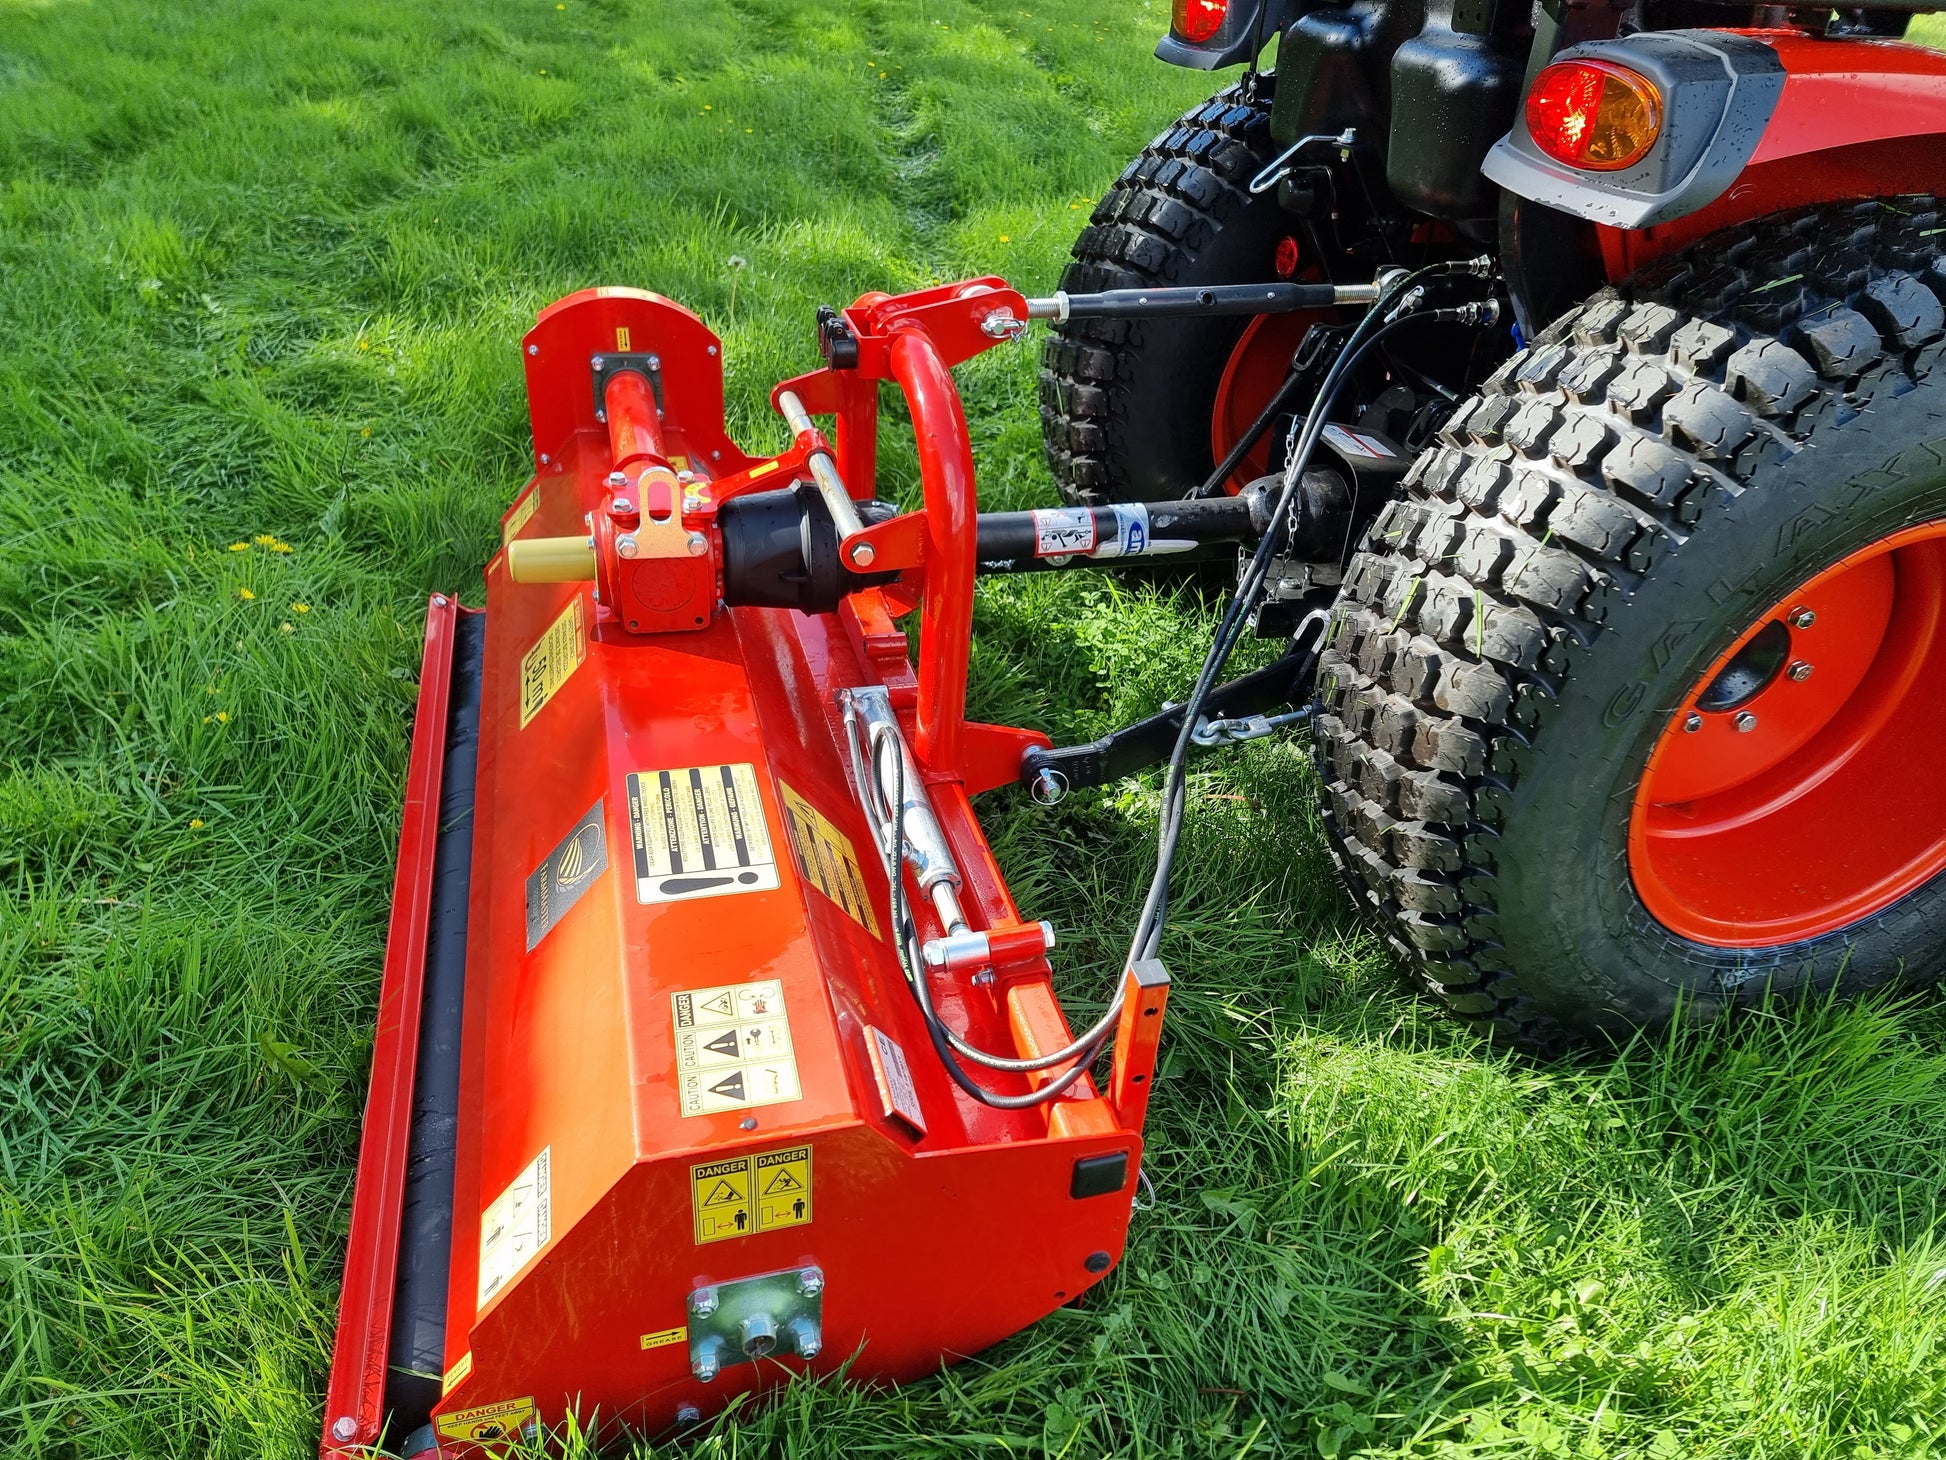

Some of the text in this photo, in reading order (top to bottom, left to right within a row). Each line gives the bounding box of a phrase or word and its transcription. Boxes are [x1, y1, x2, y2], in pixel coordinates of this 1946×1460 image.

[532, 655, 547, 703] 50 m
[631, 796, 640, 818] DANGER
[663, 787, 673, 813] PERICOLO
[694, 788, 703, 809] DANGER
[726, 787, 736, 807] GEFAHR
[634, 822, 643, 849] WARNING
[666, 817, 678, 852] ATTENZIONE
[698, 813, 709, 844] ATTENTION
[731, 811, 743, 839] WARNUNG
[677, 993, 694, 1028] DANGER
[683, 1034, 696, 1067] CAUTION
[688, 1076, 701, 1111] CAUTION
[697, 1160, 746, 1178] DANGER
[758, 1150, 807, 1167] DANGER
[646, 1336, 682, 1347] GREASE
[455, 1402, 516, 1421] DANGER
